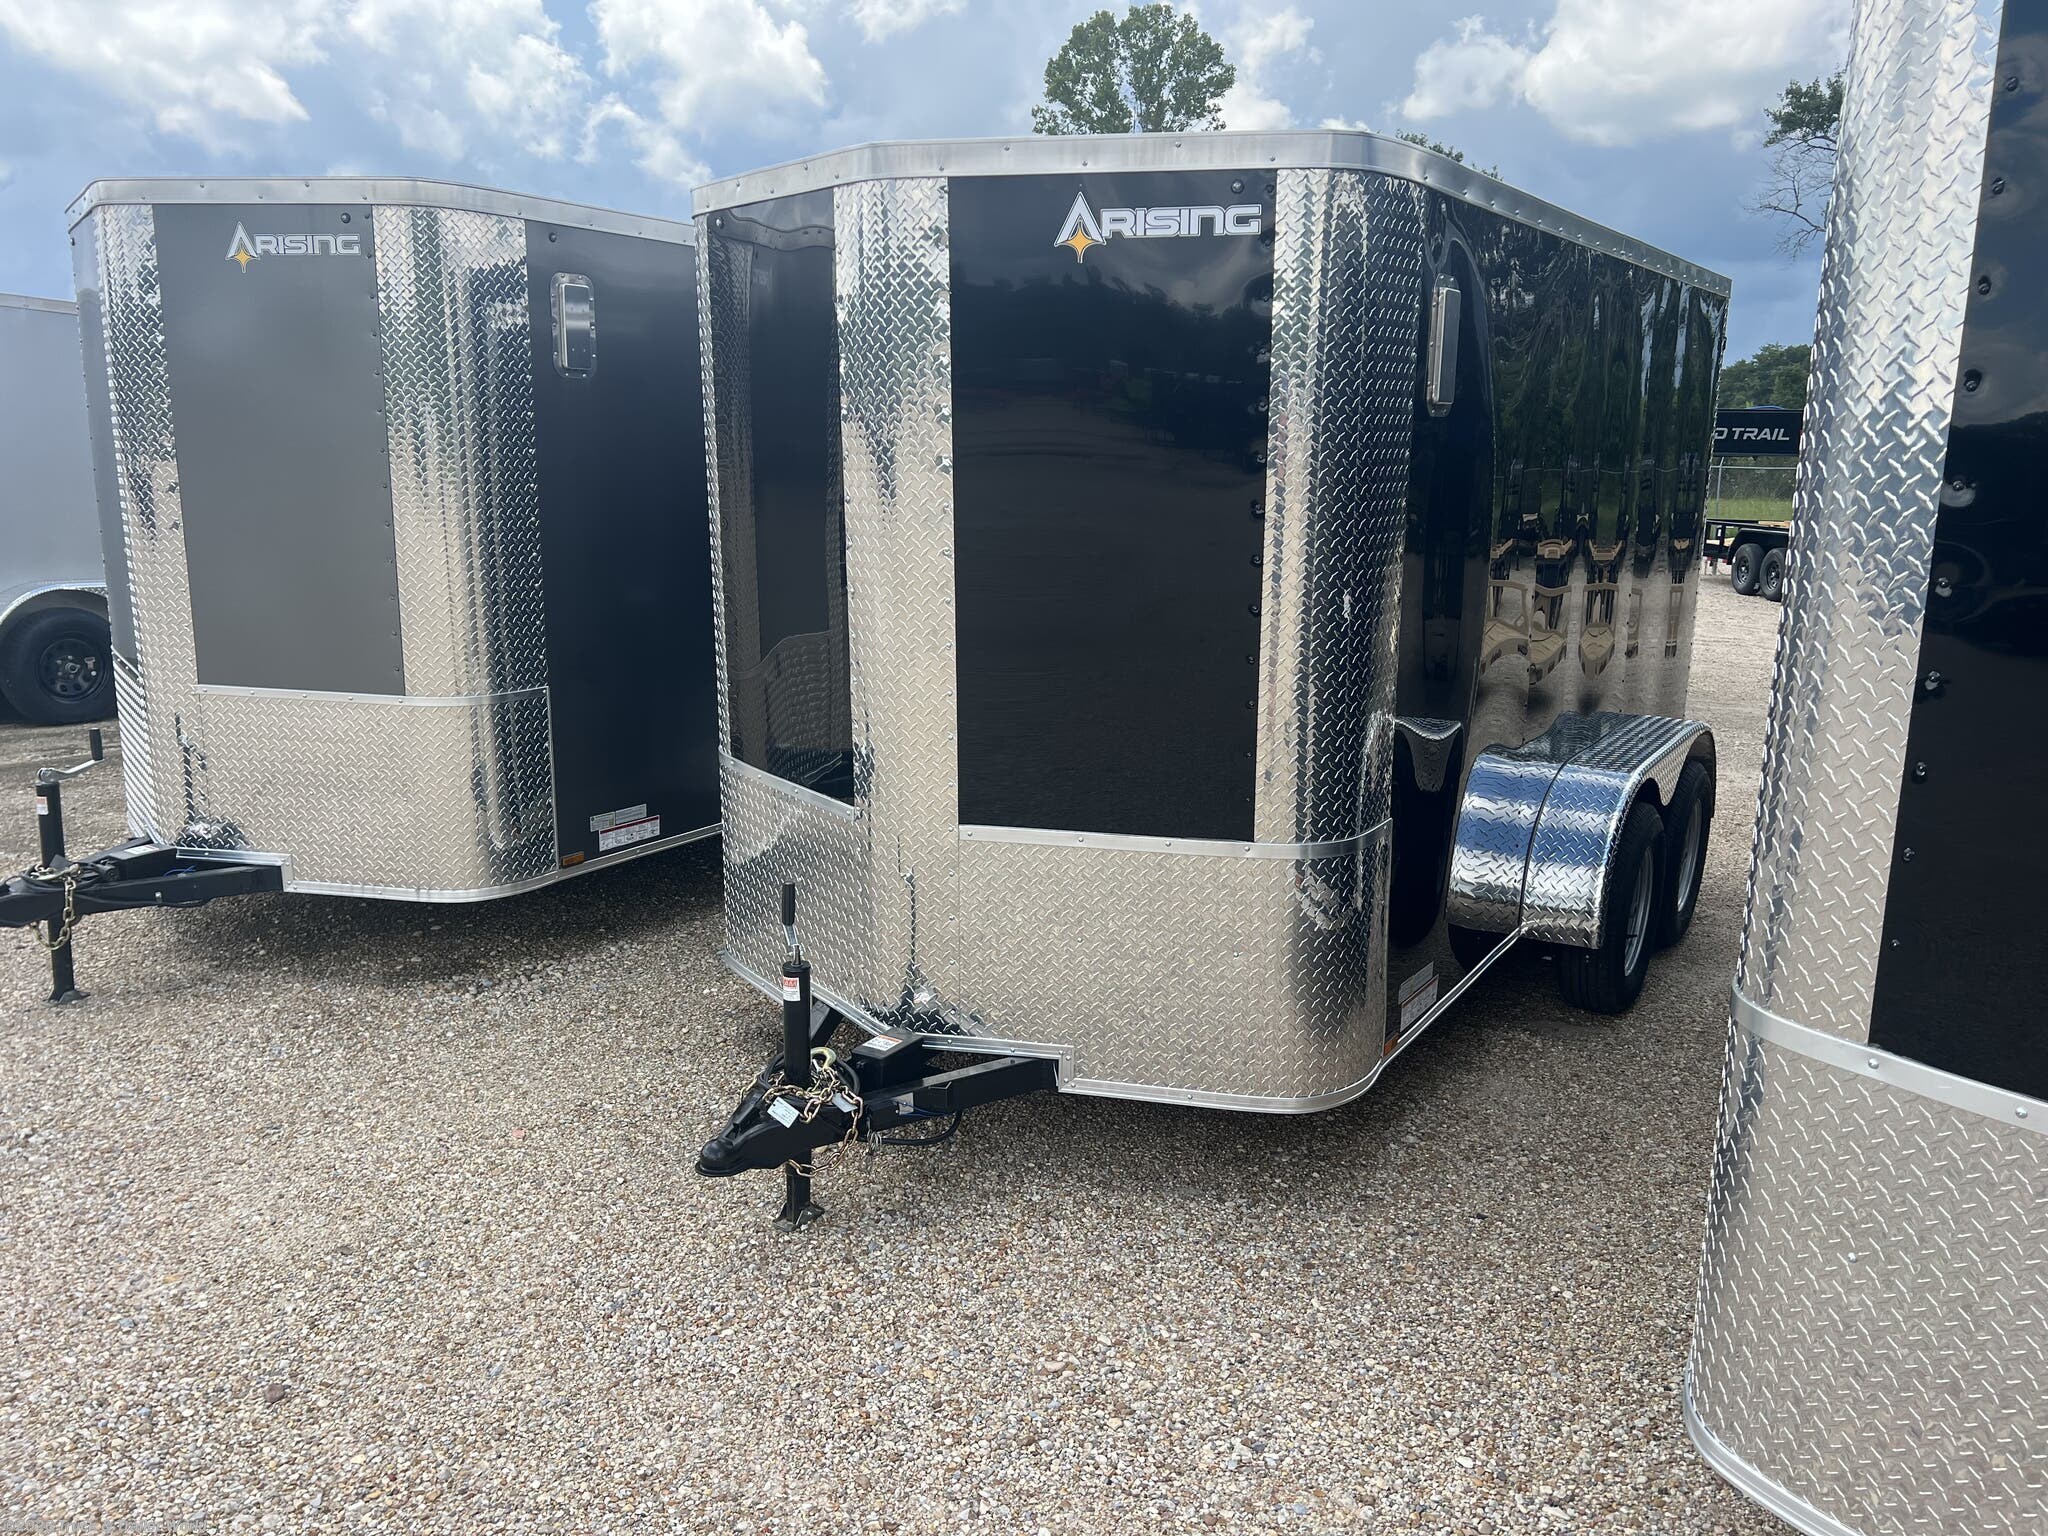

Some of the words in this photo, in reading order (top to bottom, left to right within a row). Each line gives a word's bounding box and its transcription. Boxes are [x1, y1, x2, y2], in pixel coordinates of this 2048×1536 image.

[1054, 191, 1262, 248] ARISING
[225, 221, 361, 261] ARISING
[1732, 427, 1790, 441] TRAIL
